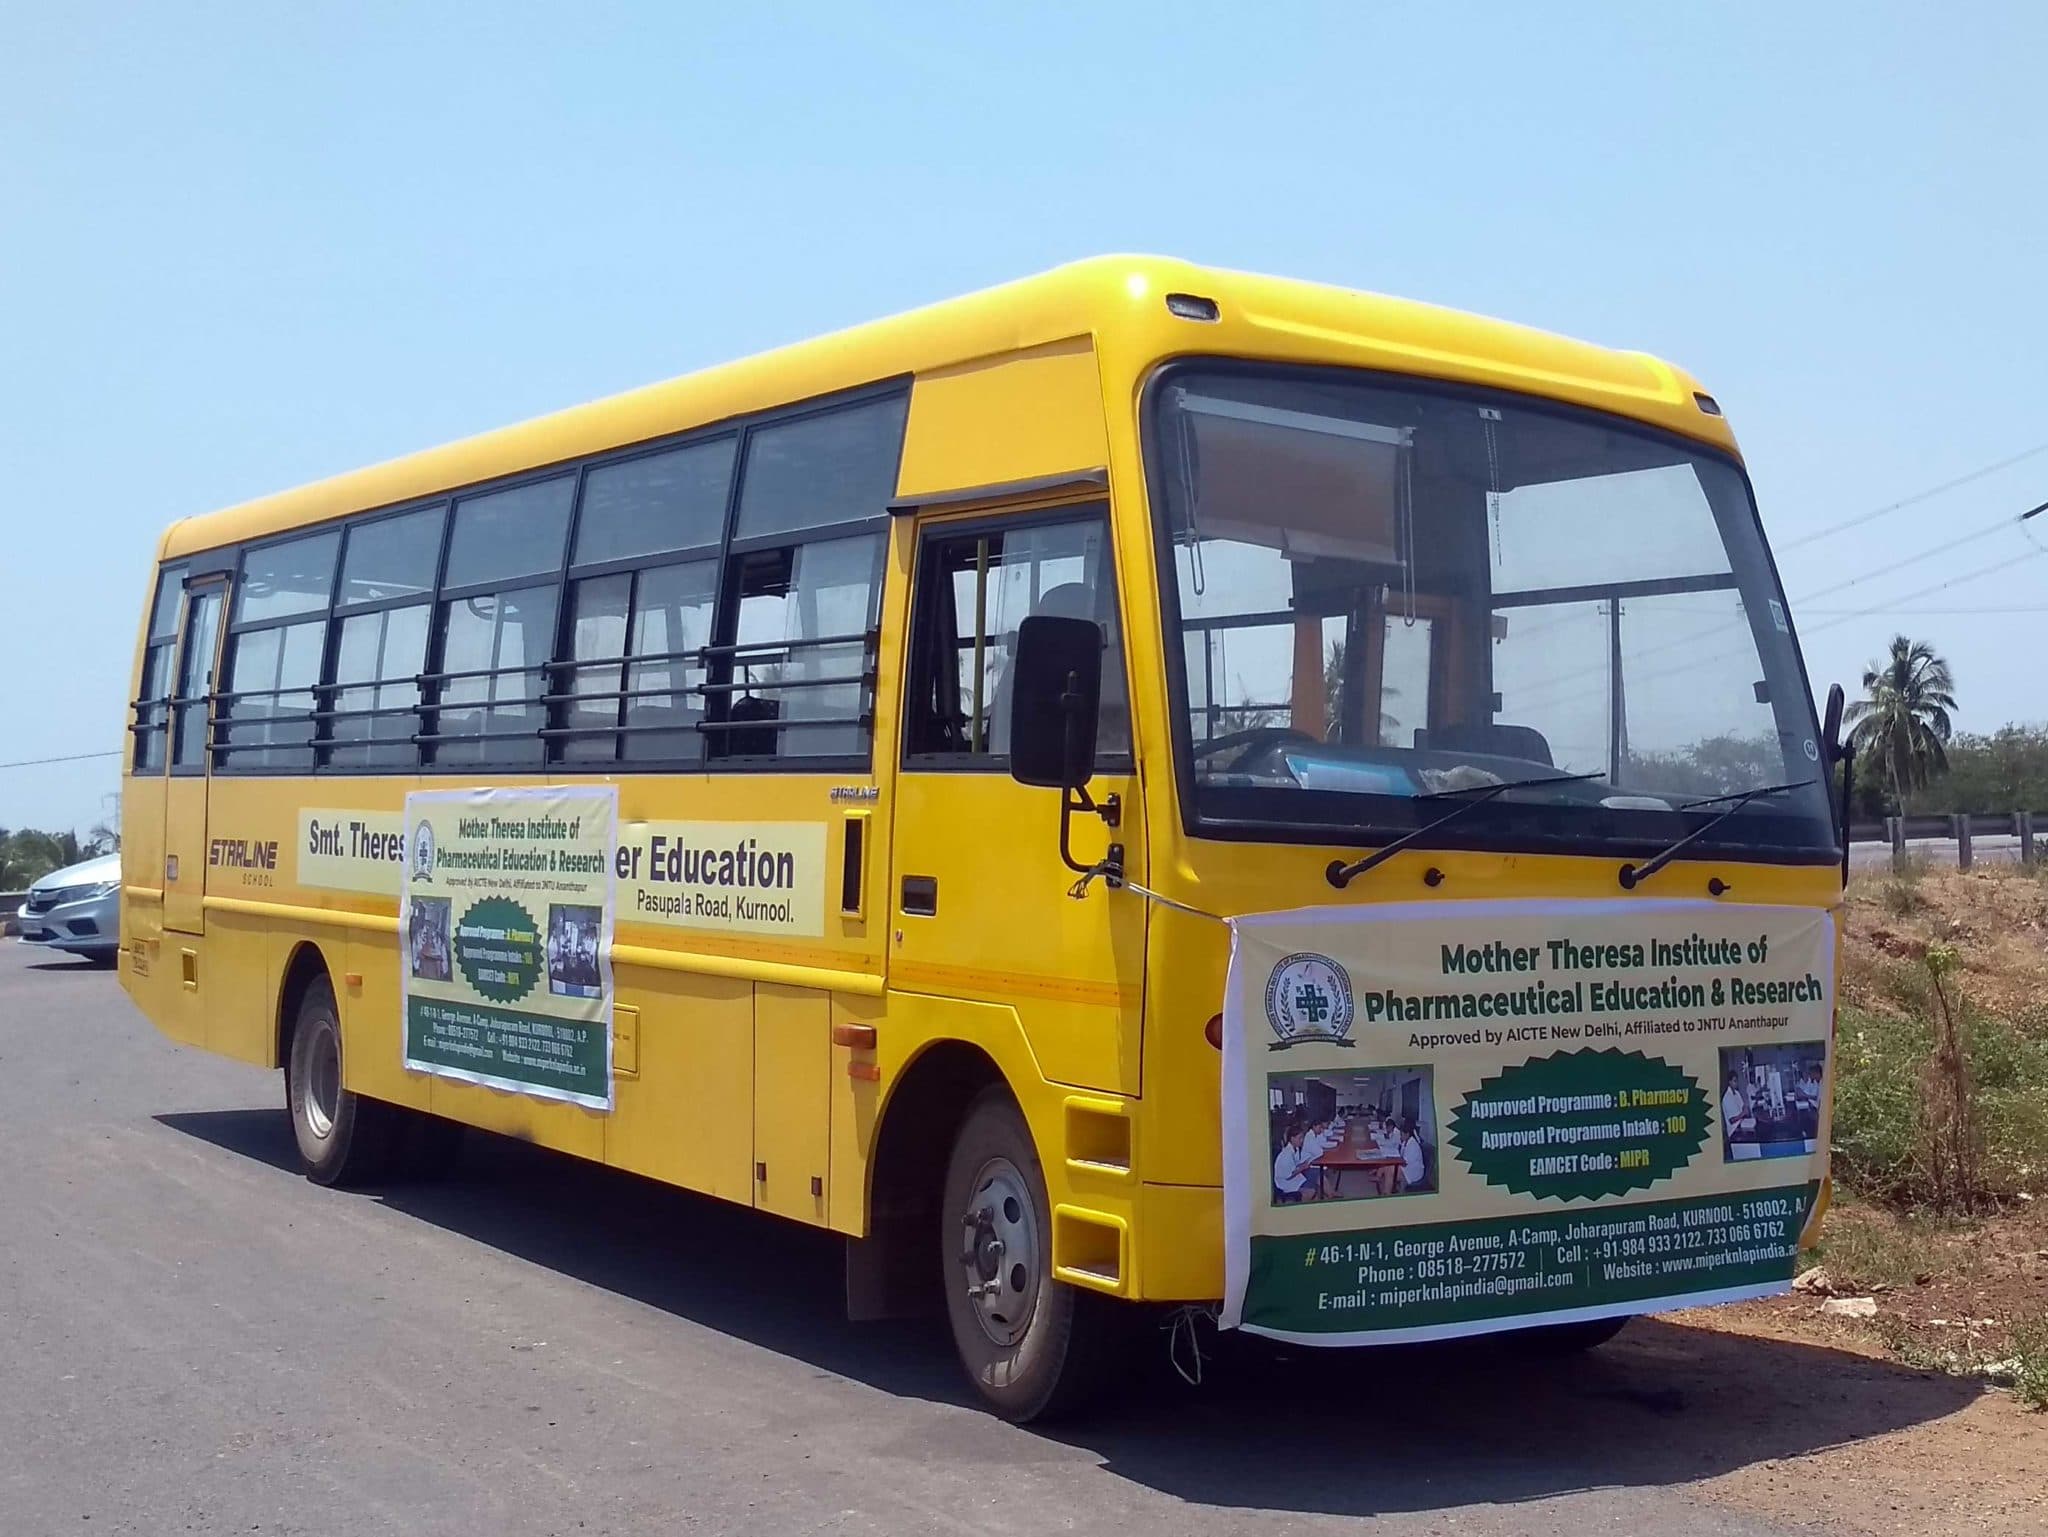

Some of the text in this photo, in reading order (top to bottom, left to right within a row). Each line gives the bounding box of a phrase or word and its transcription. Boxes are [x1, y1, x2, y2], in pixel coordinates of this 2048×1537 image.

[458, 814, 581, 840] Mother Theresa Institute of
[209, 838, 278, 870] STARLINE
[309, 819, 344, 857] Smt.
[615, 844, 642, 879] er
[650, 835, 795, 889] Education
[436, 845, 605, 874] Pharmaceutical Education & Research
[241, 872, 273, 887] SCHOOL
[637, 888, 795, 923] Pasupala Road, Kurnool.
[1440, 933, 1767, 974] Mother Theresa Institute of
[1364, 973, 1823, 1023] Pharmaceutical Education & Research
[1408, 1015, 1789, 1050] Approved by AICTE New Delhi, Affiliated to JNTU Ananthapur
[1471, 1096, 1536, 1119] Approved
[1538, 1093, 1612, 1114] Programme
[1618, 1090, 1631, 1108] B.
[1632, 1087, 1689, 1106] Pharmacy
[1481, 1126, 1545, 1150] Approved
[1547, 1123, 1621, 1144] Programme
[1622, 1118, 1660, 1137] Intake
[1665, 1115, 1686, 1133] 100
[1529, 1155, 1579, 1177] EAMCET
[1580, 1152, 1612, 1171] Code
[1305, 1247, 1317, 1267] #
[1320, 1241, 1389, 1265] 46-1-N-1,
[1394, 1240, 1445, 1259] George
[1448, 1233, 1504, 1253] Avenue,
[1508, 1227, 1561, 1246] A-Camp,
[1564, 1217, 1646, 1241] Joharapuram
[1649, 1212, 1680, 1232] Road,
[1682, 1206, 1734, 1227] KURNOOL
[1743, 1198, 1792, 1220] 518002,
[1557, 1245, 1581, 1264] Cell
[1592, 1238, 1645, 1260] +91-984
[1649, 1235, 1672, 1254] 933
[1674, 1230, 1705, 1251] 2122.
[1707, 1227, 1727, 1246] 733
[1729, 1224, 1750, 1243] 066
[1754, 1219, 1785, 1239] 6762
[1358, 1264, 1405, 1284] Phone
[1602, 1260, 1652, 1281] Website
[1318, 1290, 1366, 1310] E-mail
[1380, 1272, 1573, 1308] miperknlapindia@gmail.com
